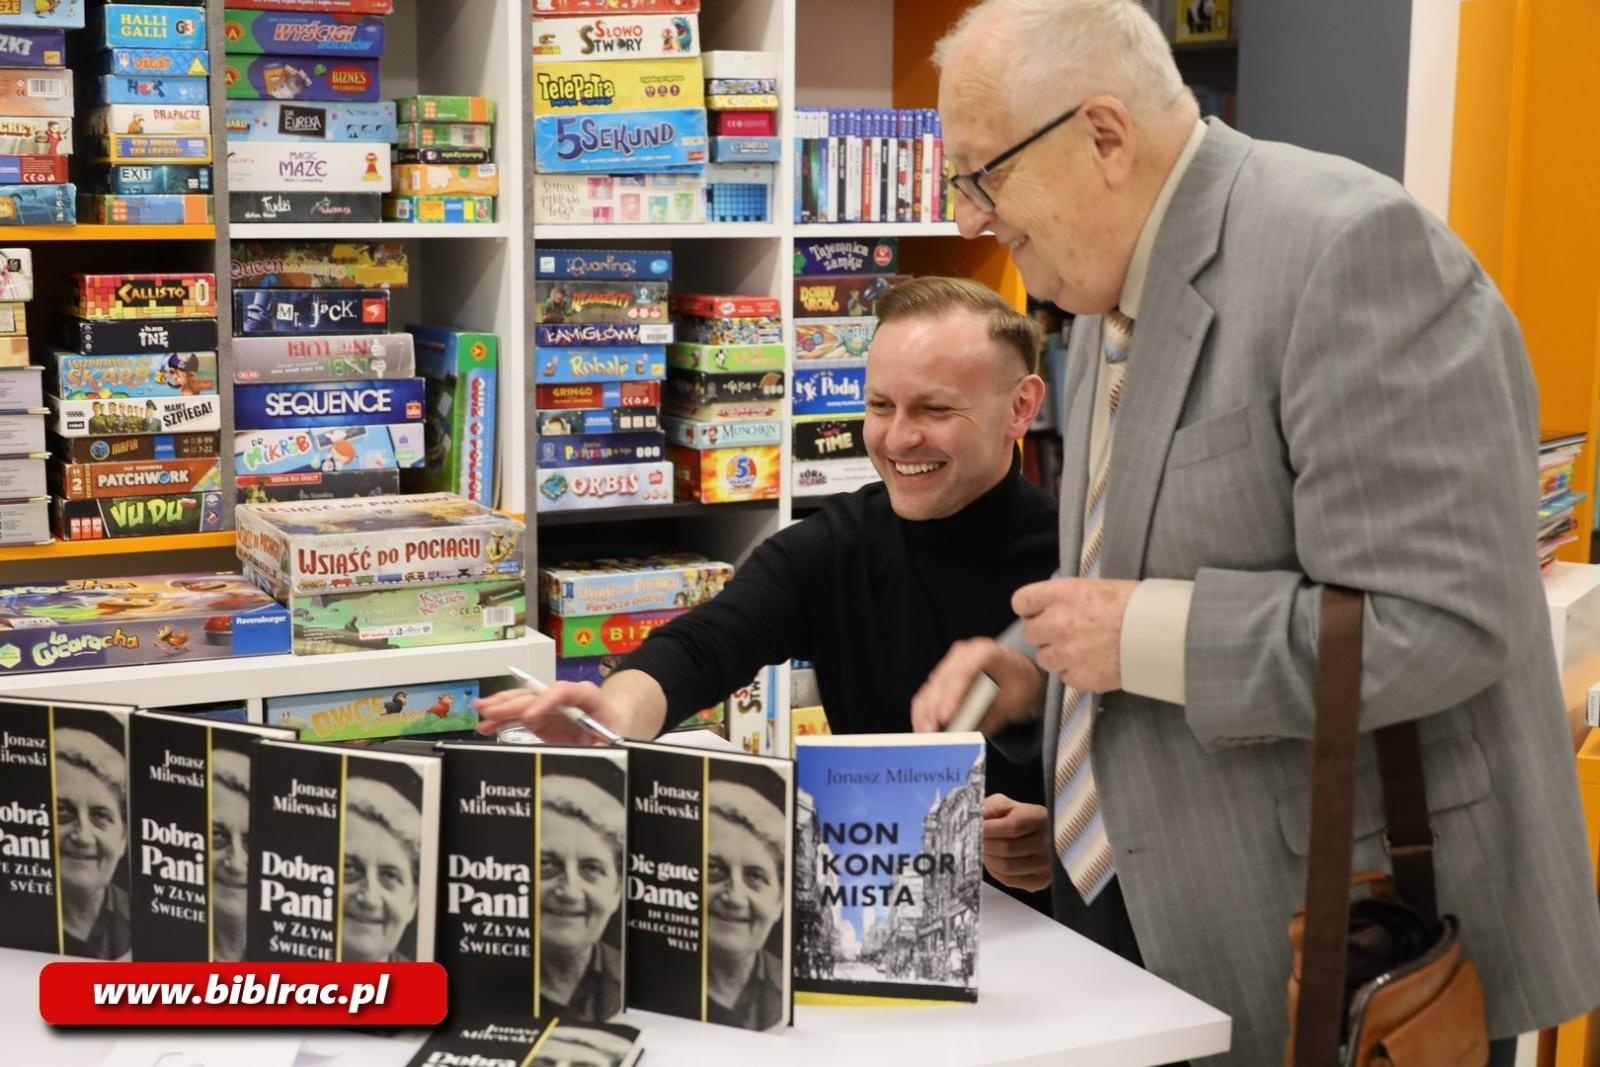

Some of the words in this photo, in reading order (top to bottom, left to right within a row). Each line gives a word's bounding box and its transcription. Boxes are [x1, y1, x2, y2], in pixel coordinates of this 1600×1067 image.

[120, 13, 167, 27] HALLI
[120, 26, 167, 38] GALLI
[273, 21, 357, 42] WYŚCIGI
[331, 71, 367, 84] BIZNES
[153, 108, 202, 121] DRAPACZE
[284, 114, 322, 131] EUREKA
[288, 151, 318, 161] MAGIC
[122, 168, 151, 181] EXIT
[278, 160, 328, 177] MAZE
[118, 283, 186, 304] CALLISTO
[552, 386, 593, 397] GRINGO
[820, 376, 861, 400] Podaj
[164, 403, 185, 412] MAMY
[265, 389, 392, 417] SEQUENCE
[162, 401, 213, 428] SZPIEGA!
[111, 439, 140, 455] MAFIA
[814, 432, 853, 454] TIME
[97, 469, 190, 487] PATCHWORK
[571, 472, 640, 497] ORBIS
[298, 546, 371, 576] WSIĄŚĆ
[377, 551, 399, 567] DO
[405, 538, 481, 564] POCIĄGU
[235, 615, 287, 625] Ravensburger
[609, 626, 652, 641] BIZ
[310, 695, 386, 737] OWCE
[2, 731, 47, 750] Jonasz
[0, 750, 48, 767] ilewski
[162, 749, 206, 769] Jonasz
[149, 764, 205, 788] Milewski
[826, 768, 880, 787] Jonasz
[885, 767, 961, 785] Milewski
[287, 778, 338, 799] Jonasz
[477, 780, 532, 800] Jonasz
[651, 780, 700, 803] Jonasz
[0, 800, 50, 828] obrá
[272, 795, 338, 819] Milewski
[460, 797, 531, 818] Milewski
[634, 796, 700, 821] Milewski
[141, 817, 206, 852] Dobra
[822, 822, 899, 846] NON
[15, 862, 53, 878] ZLÉM
[141, 843, 205, 886] Pani
[261, 850, 336, 886] Dobra
[448, 853, 531, 883] Dobra
[657, 860, 700, 882] gute
[822, 853, 957, 877] KONFOR
[168, 885, 207, 906] ZŁYM
[259, 878, 334, 923] Pani
[447, 881, 530, 919] Pani
[627, 875, 699, 912] Dame
[821, 885, 916, 908] MISTA
[150, 897, 207, 924] ŚWIECIE
[290, 922, 334, 943] ZŁYM
[482, 921, 531, 939] ZŁYM
[269, 935, 334, 962] ŚWIECIE
[459, 936, 531, 958] ŚWIECIE
[667, 936, 699, 953] WELT
[459, 1028, 536, 1045] Milewski
[484, 1022, 541, 1036] Jonasz
